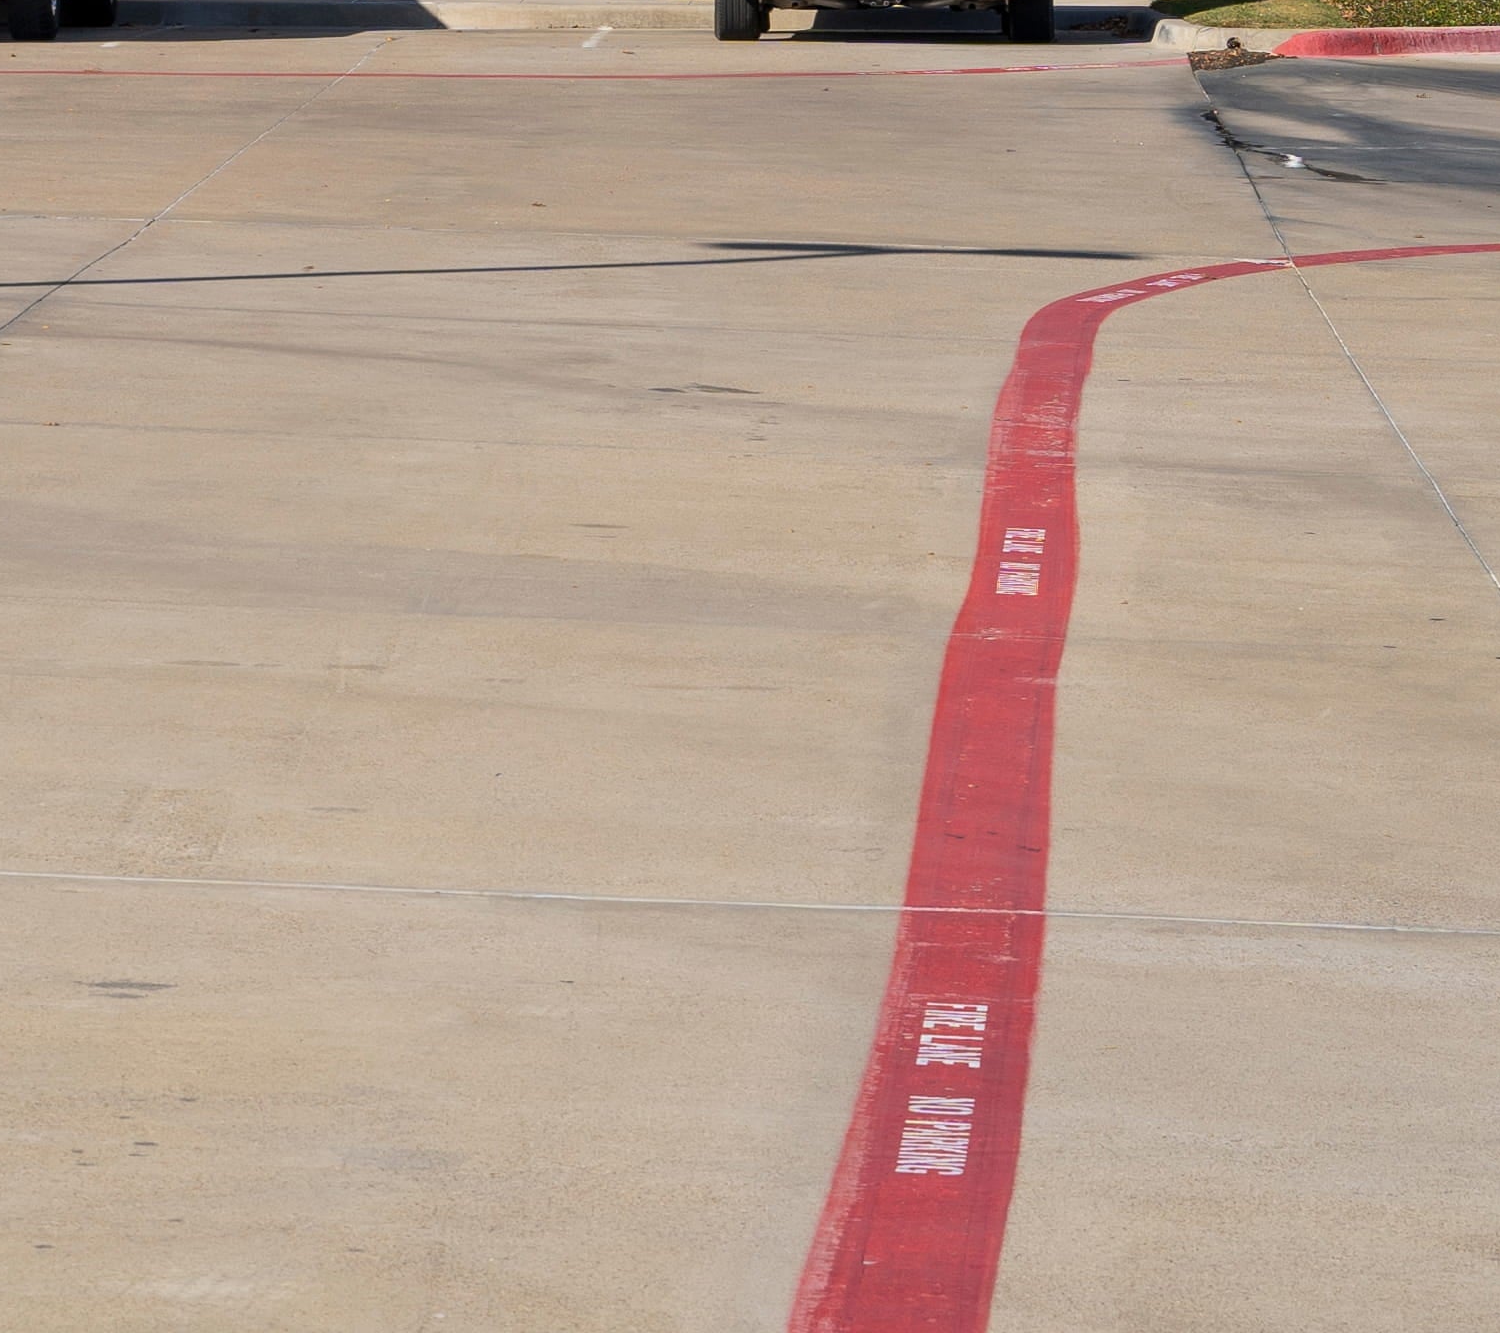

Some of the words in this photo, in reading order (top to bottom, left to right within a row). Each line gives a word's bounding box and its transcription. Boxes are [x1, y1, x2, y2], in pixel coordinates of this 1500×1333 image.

[922, 1002, 988, 1031] FIRE
[916, 1034, 984, 1068] LANE
[908, 1095, 976, 1115] NO
[895, 1119, 972, 1175] PARKING
